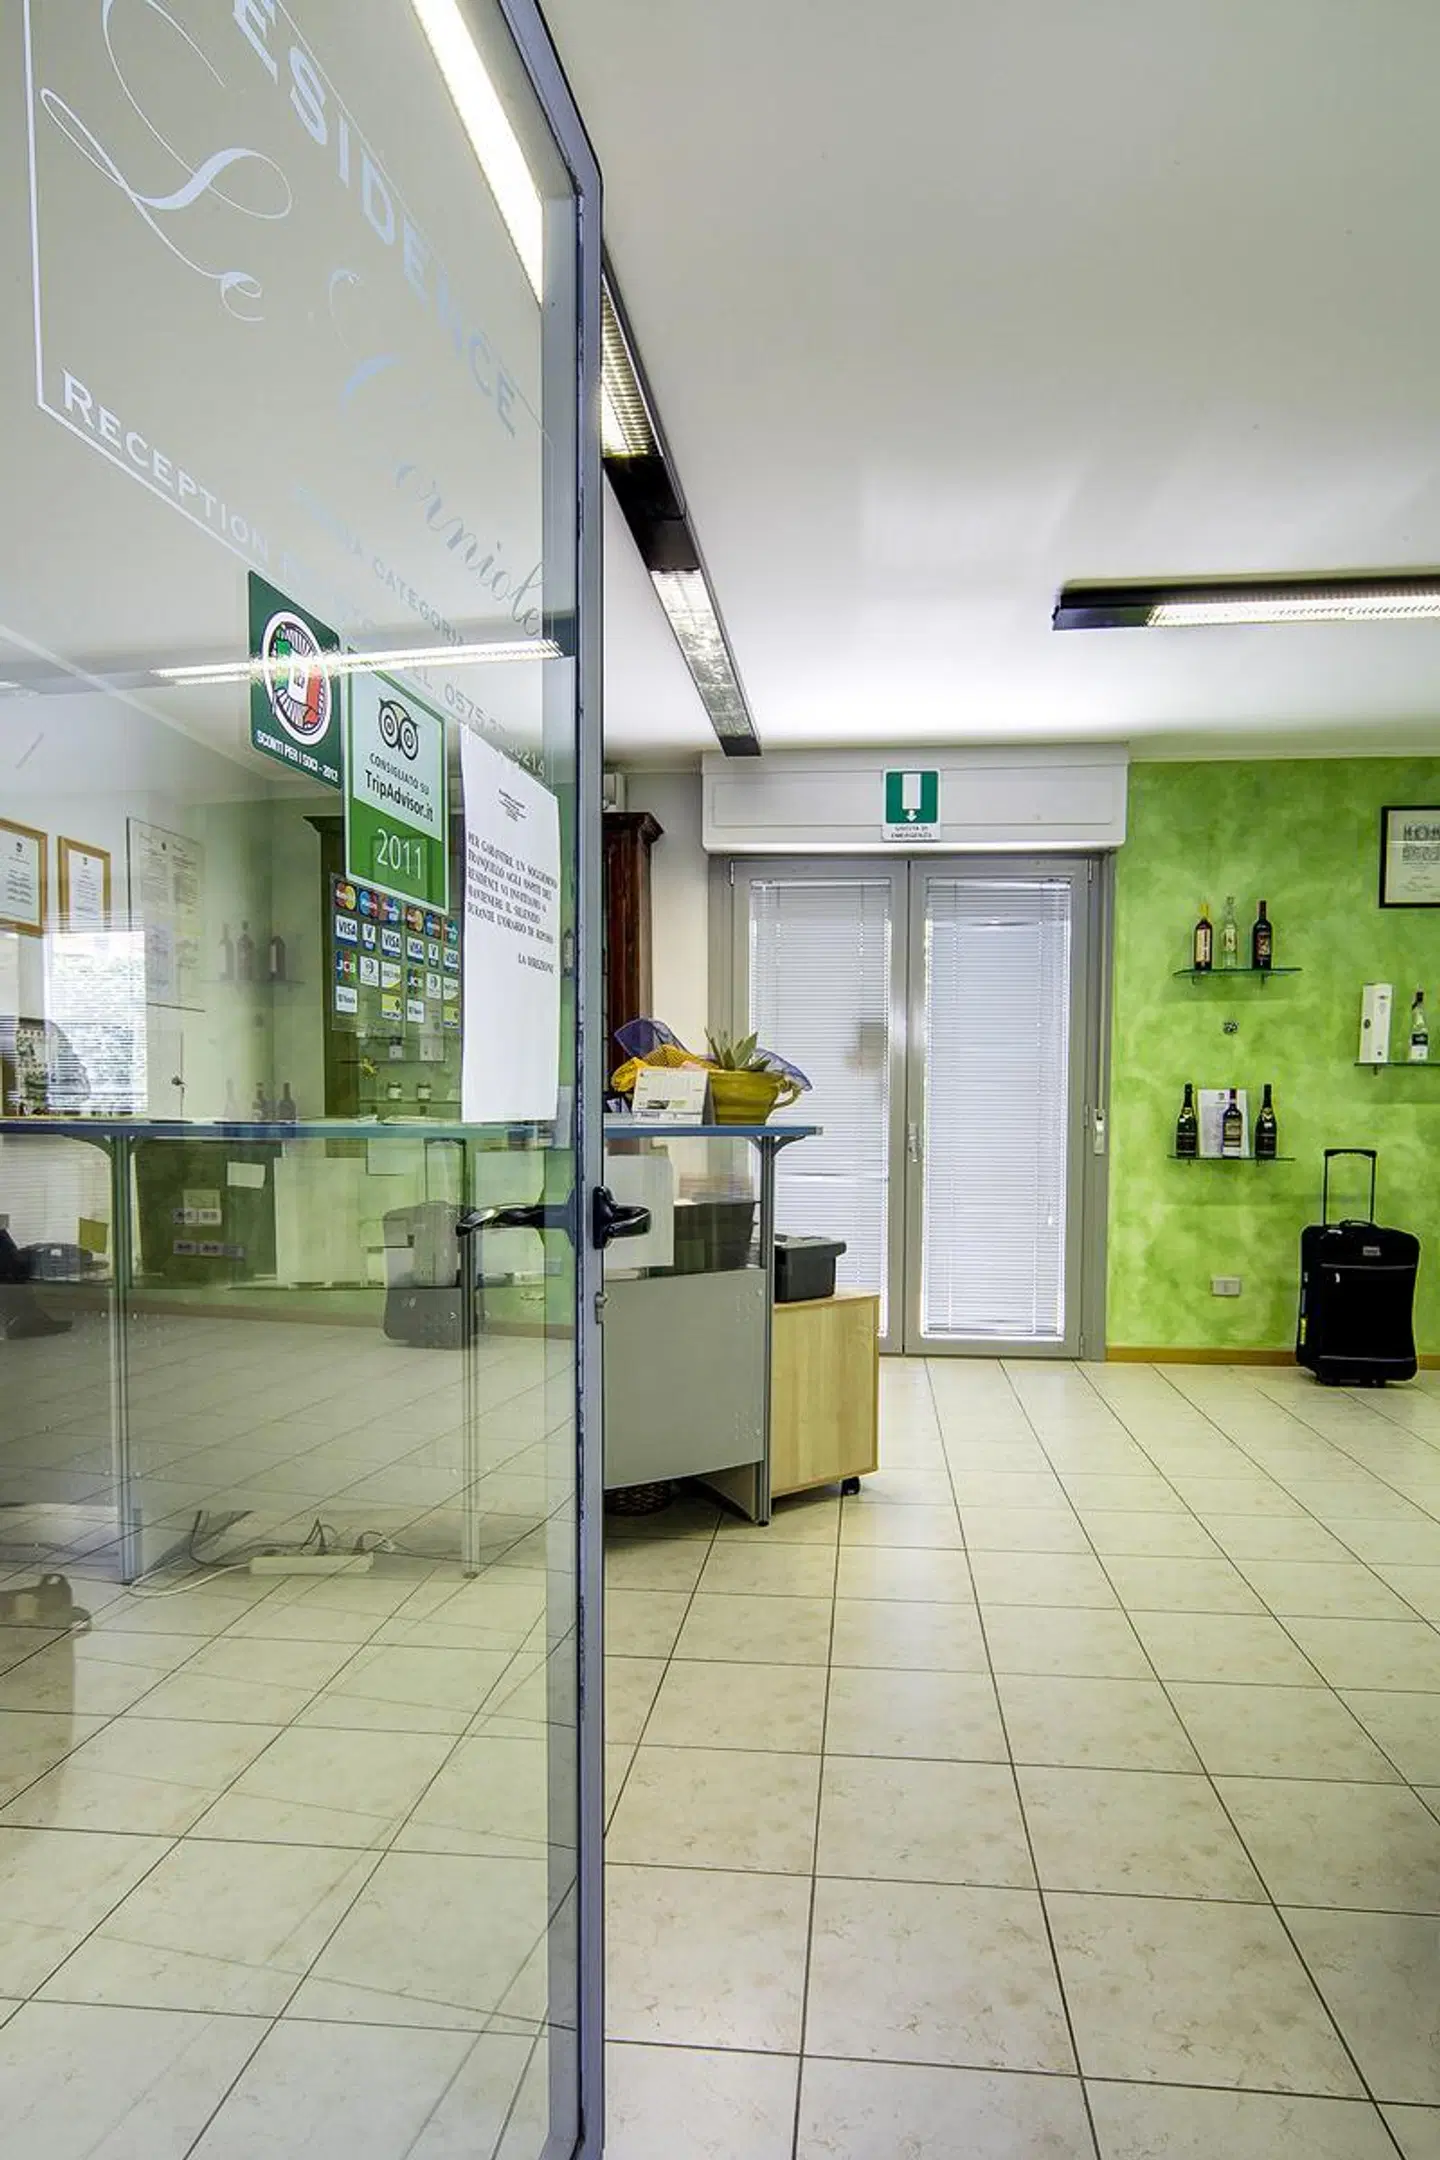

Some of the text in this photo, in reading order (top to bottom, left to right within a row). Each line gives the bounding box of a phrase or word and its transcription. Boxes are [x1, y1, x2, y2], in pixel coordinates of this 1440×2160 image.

[62, 367, 268, 566] RECEPTION
[370, 752, 430, 795] CONSIGLIATO SU
[377, 828, 421, 880] 2011
[340, 921, 356, 936] VISA
[383, 934, 400, 948] VISA
